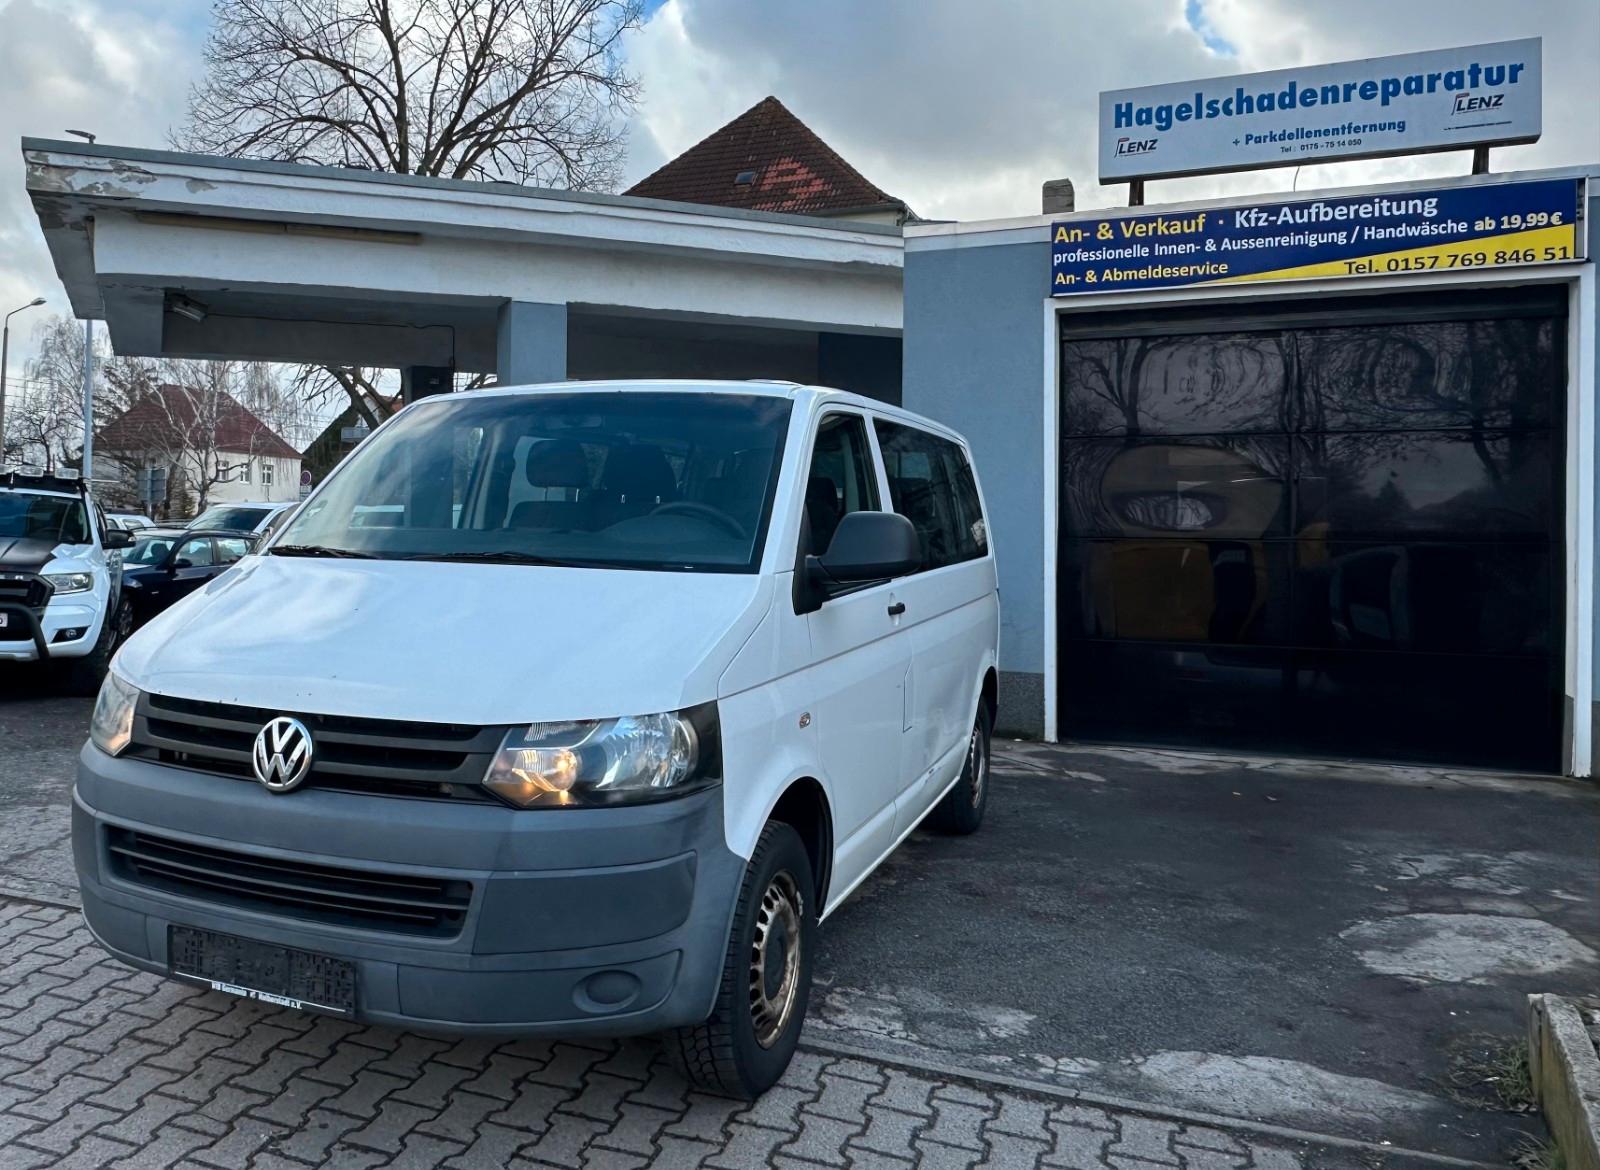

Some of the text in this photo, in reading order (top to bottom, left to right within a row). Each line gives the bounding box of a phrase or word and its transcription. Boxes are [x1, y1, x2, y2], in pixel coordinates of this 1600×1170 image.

[1114, 63, 1524, 131] Hagelschadenreparatur
[1456, 94, 1505, 111] LENZ
[1118, 138, 1158, 154] LENZ
[1245, 120, 1406, 145] Parkdellenentfernung
[1054, 226, 1091, 243] An-
[1096, 222, 1114, 240] &
[1120, 213, 1206, 238] Verkauf
[1235, 197, 1438, 228] Kfz-Aufbereitung
[1053, 244, 1149, 266] professionelle
[1154, 242, 1200, 256] Innen-
[1204, 238, 1217, 251] &
[1221, 231, 1347, 250] Aussenreinigung
[1363, 219, 1468, 240] Handwäsche
[1474, 216, 1496, 231] ab
[1055, 261, 1228, 285] An- & Abmeldeservice
[1343, 246, 1570, 275] Tel. 0157 769 846 51
[255, 718, 309, 787] VW
